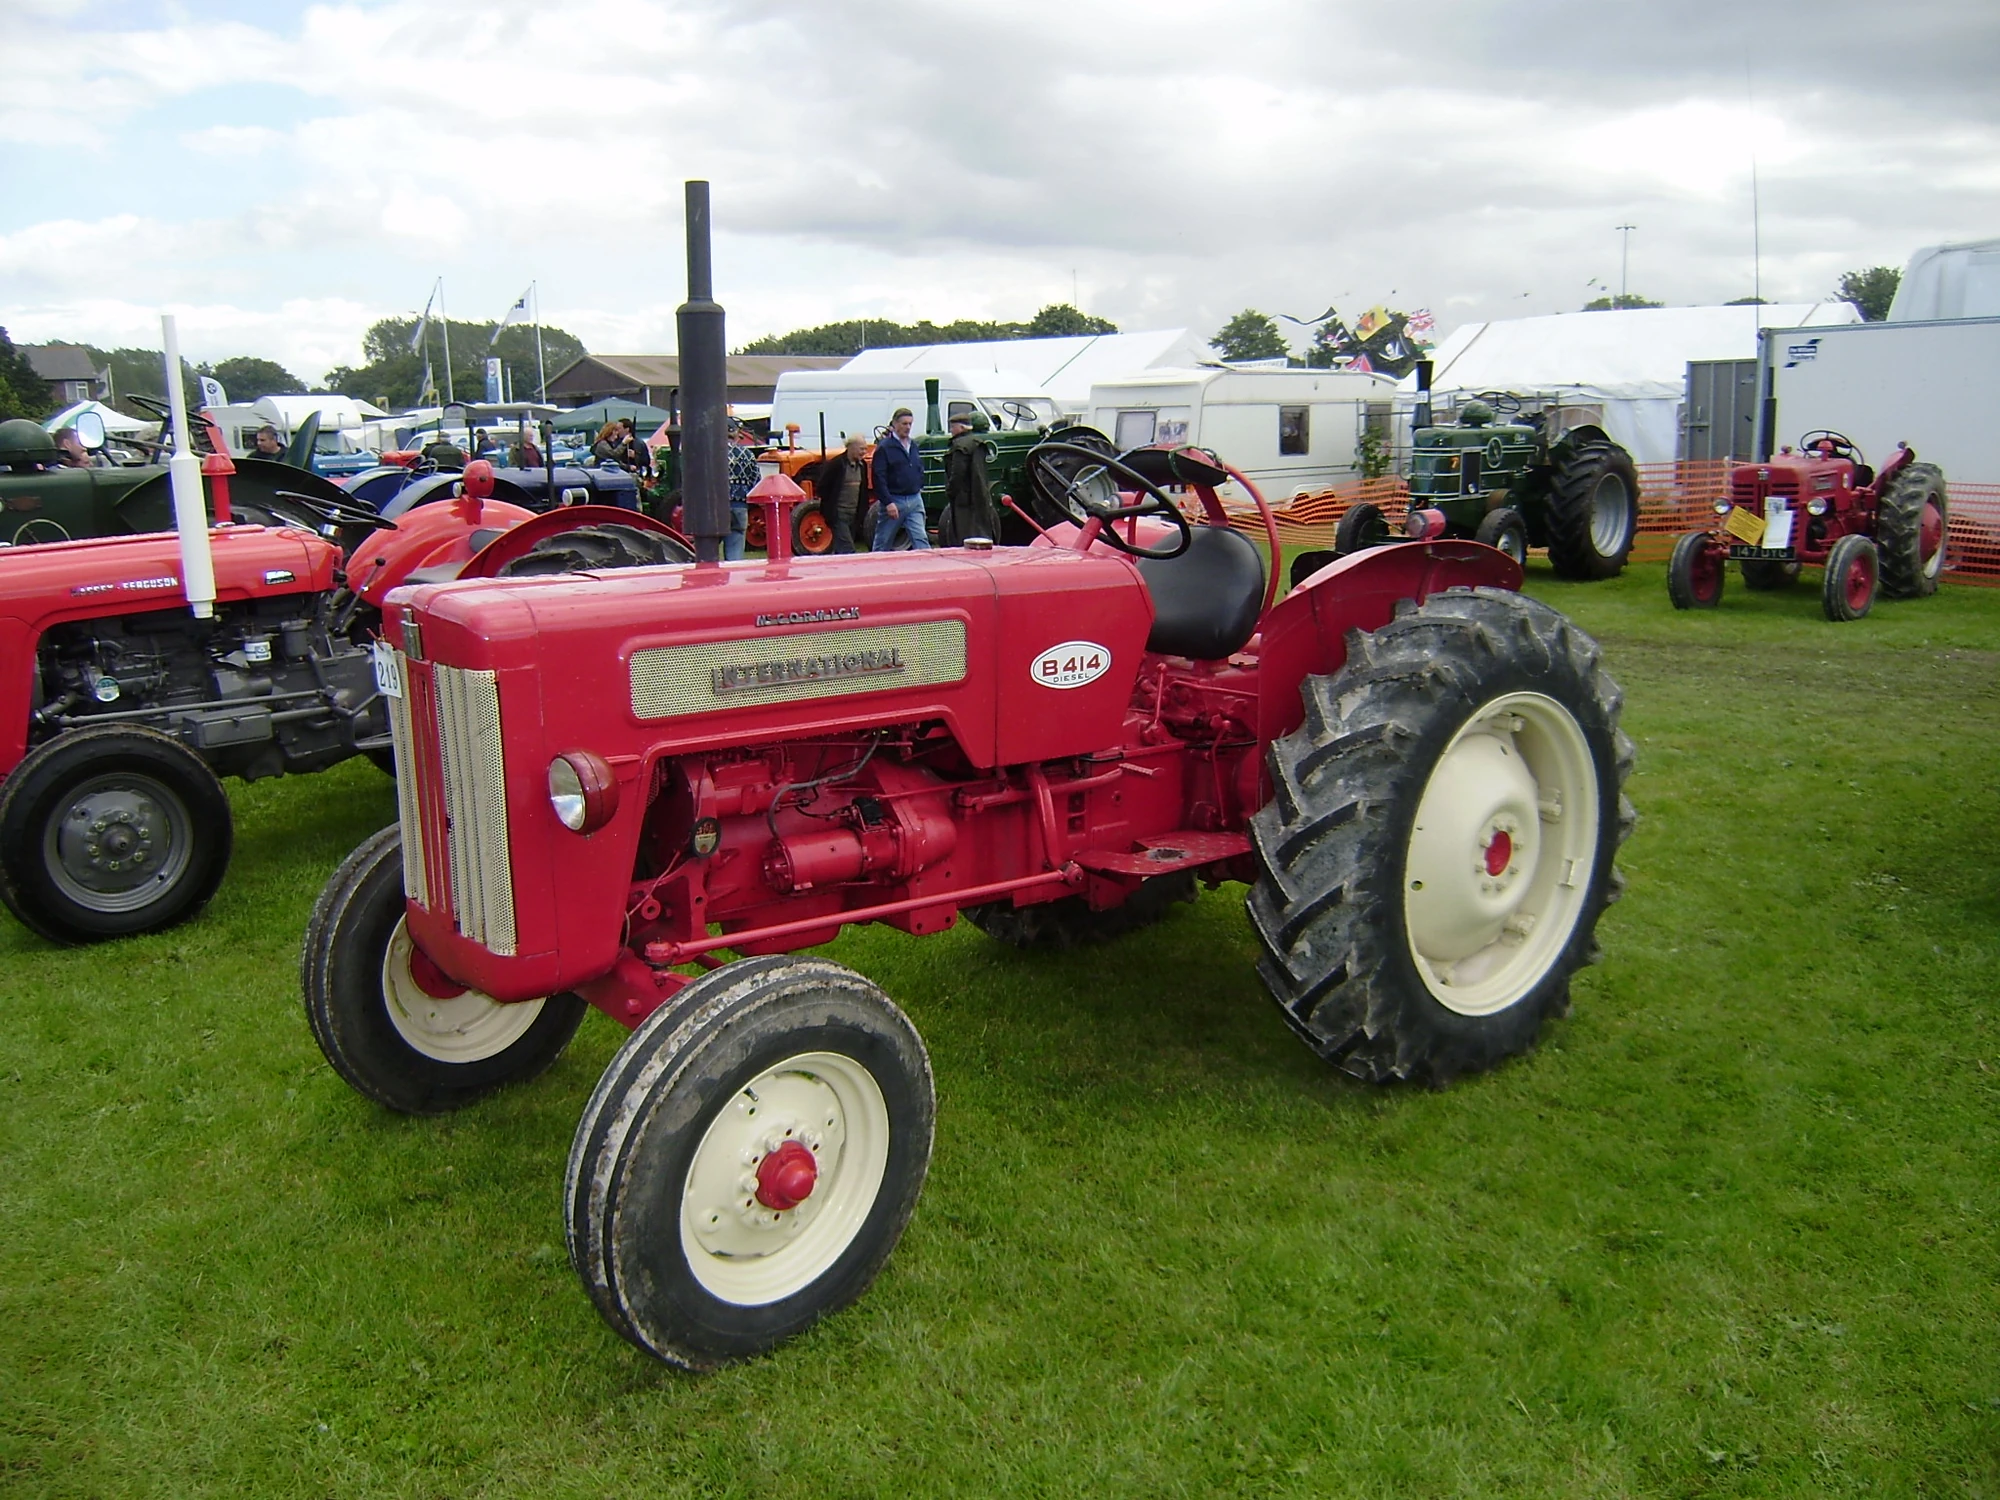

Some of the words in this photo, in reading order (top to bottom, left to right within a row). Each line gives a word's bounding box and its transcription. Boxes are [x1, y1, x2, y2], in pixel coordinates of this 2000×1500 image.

[1737, 546, 1758, 557] 147
[122, 577, 179, 591] FERGUSON
[378, 661, 399, 690] 219
[712, 648, 904, 692] INTERNATIONAL
[1053, 673, 1089, 683] DIESEL
